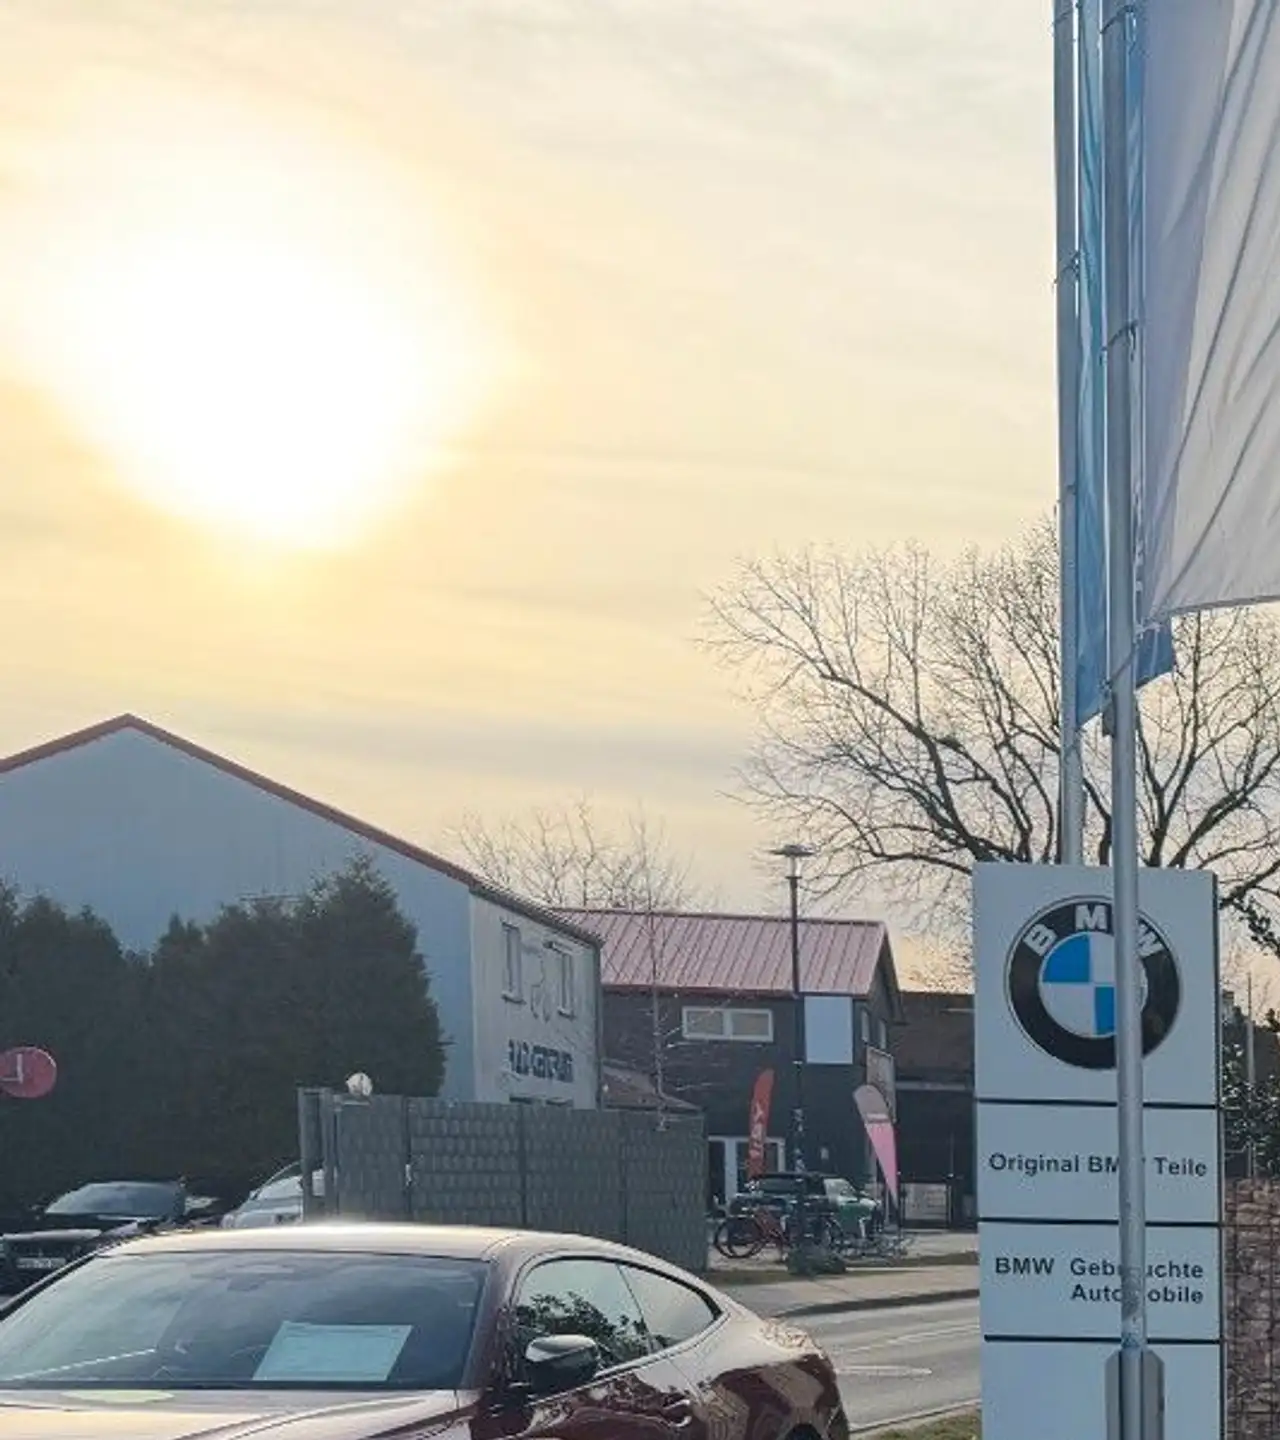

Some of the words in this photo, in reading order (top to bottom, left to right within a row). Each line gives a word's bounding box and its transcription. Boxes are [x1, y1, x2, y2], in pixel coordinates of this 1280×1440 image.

[1023, 904, 1164, 958] BMW
[988, 1152, 1079, 1178] Original
[1087, 1156, 1146, 1174] BM
[1154, 1156, 1208, 1178] Teile
[994, 1256, 1055, 1275] BMW
[1070, 1257, 1205, 1279] Gebchte
[1071, 1284, 1205, 1305] Autoobile
